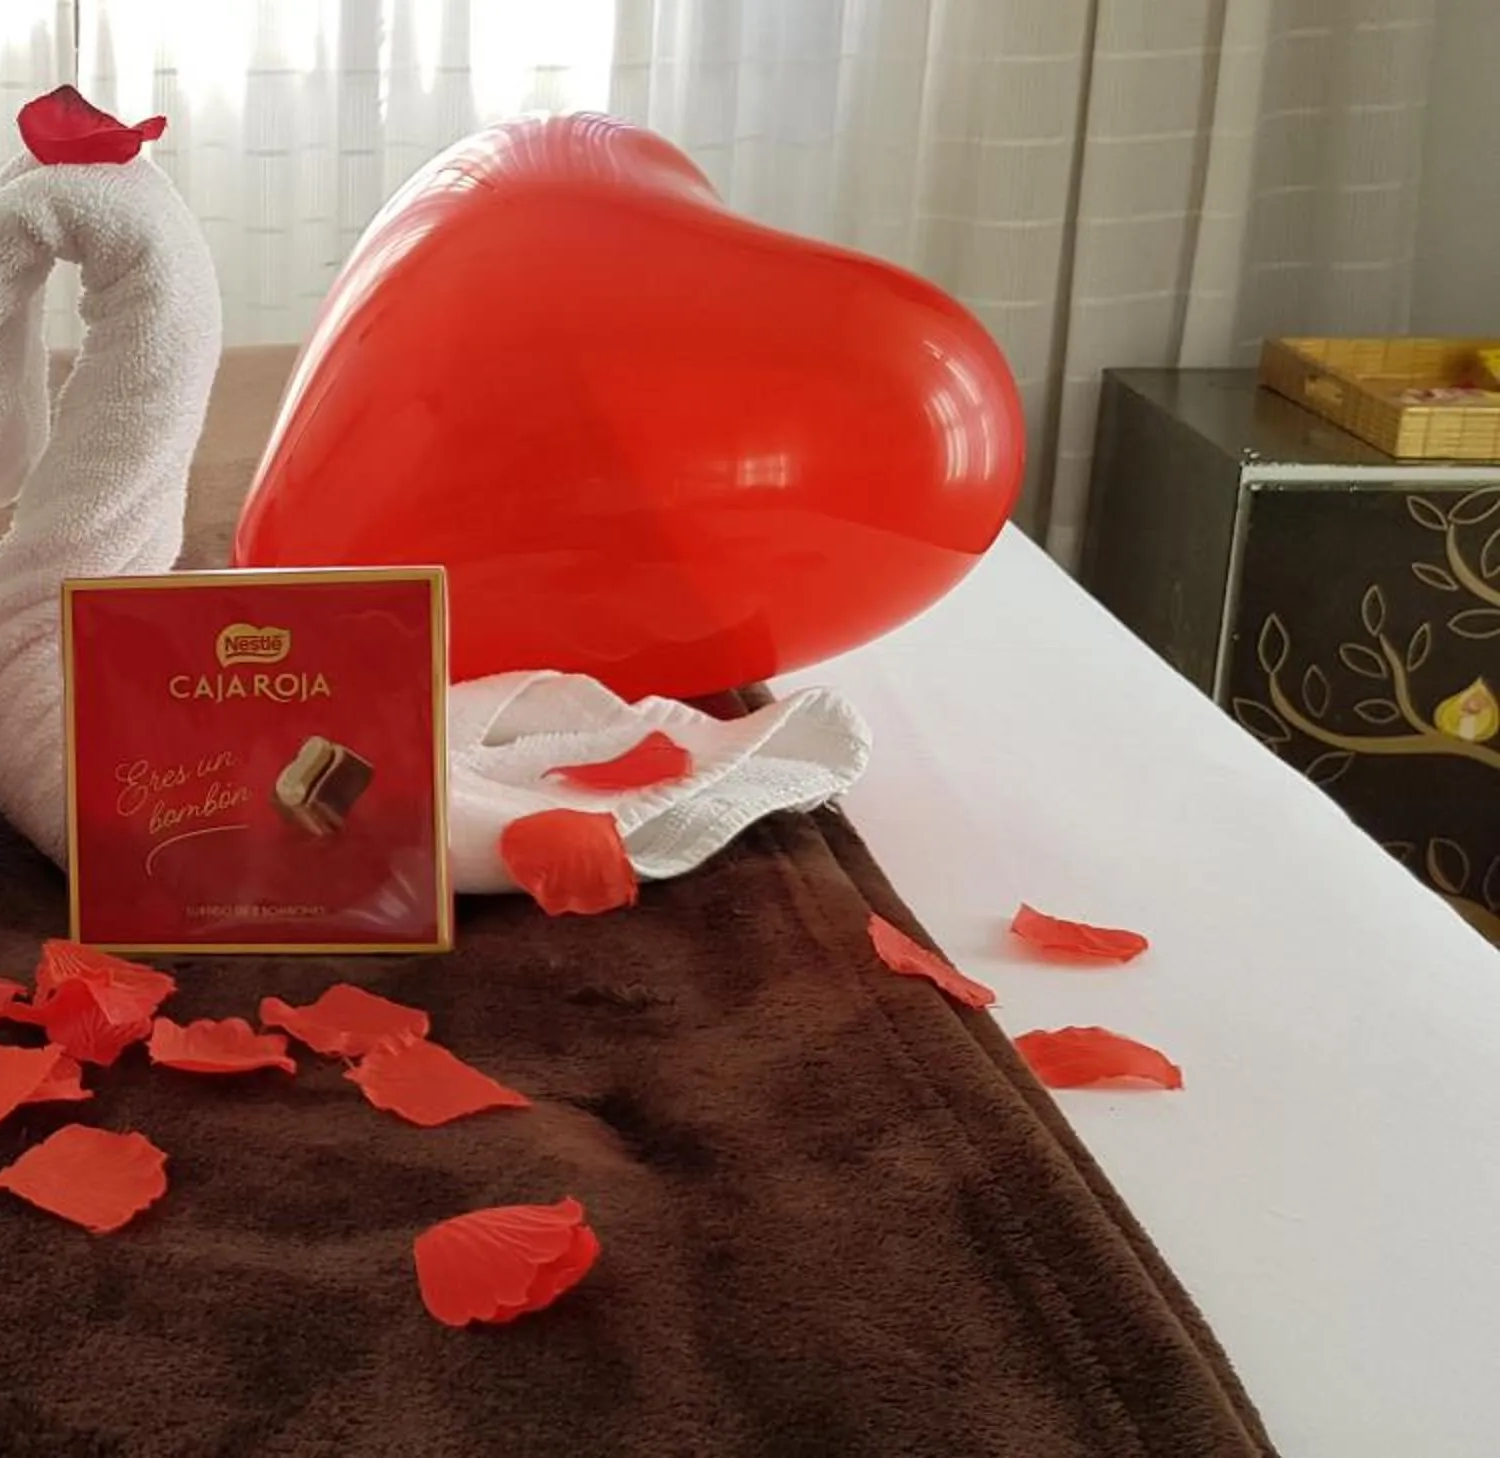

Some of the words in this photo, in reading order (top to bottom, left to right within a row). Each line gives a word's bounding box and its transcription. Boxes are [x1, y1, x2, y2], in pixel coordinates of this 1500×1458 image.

[169, 673, 246, 703] CAJA
[253, 671, 331, 703] ROJA
[115, 759, 191, 817] Eres
[197, 751, 236, 777] un
[149, 781, 249, 834] bombón
